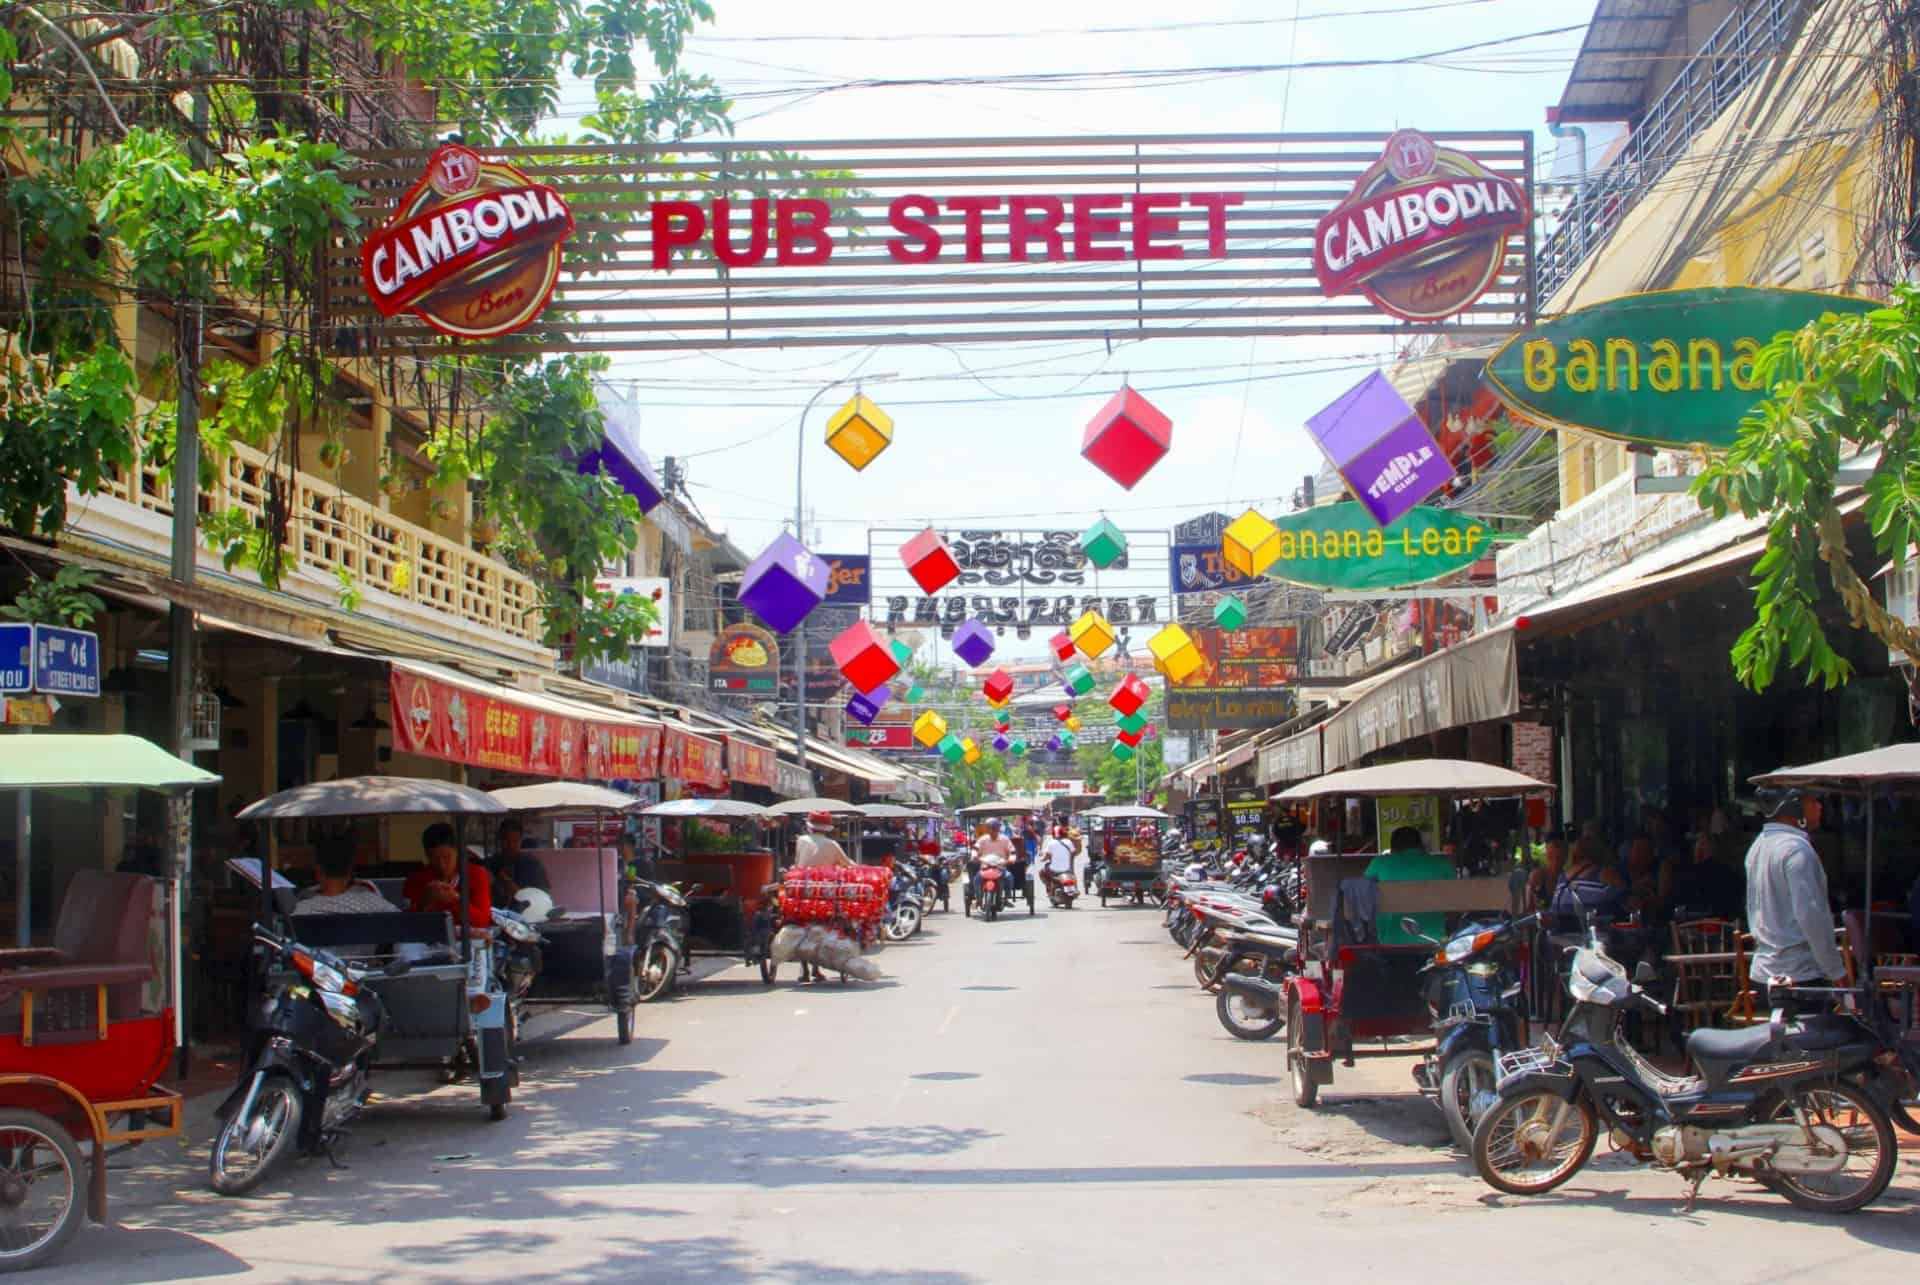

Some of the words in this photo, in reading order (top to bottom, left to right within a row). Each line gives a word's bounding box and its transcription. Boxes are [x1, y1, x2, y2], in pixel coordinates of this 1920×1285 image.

[370, 189, 568, 296] CAMBODIA
[652, 199, 833, 270] PUB
[888, 192, 1245, 265] STREET
[1322, 181, 1517, 272] CAMBODIA
[464, 285, 524, 322] Beer
[1409, 272, 1469, 304] Beer
[1523, 337, 1764, 393] Banana
[1367, 445, 1434, 499] TEMPLE
[1279, 528, 1384, 559] anana
